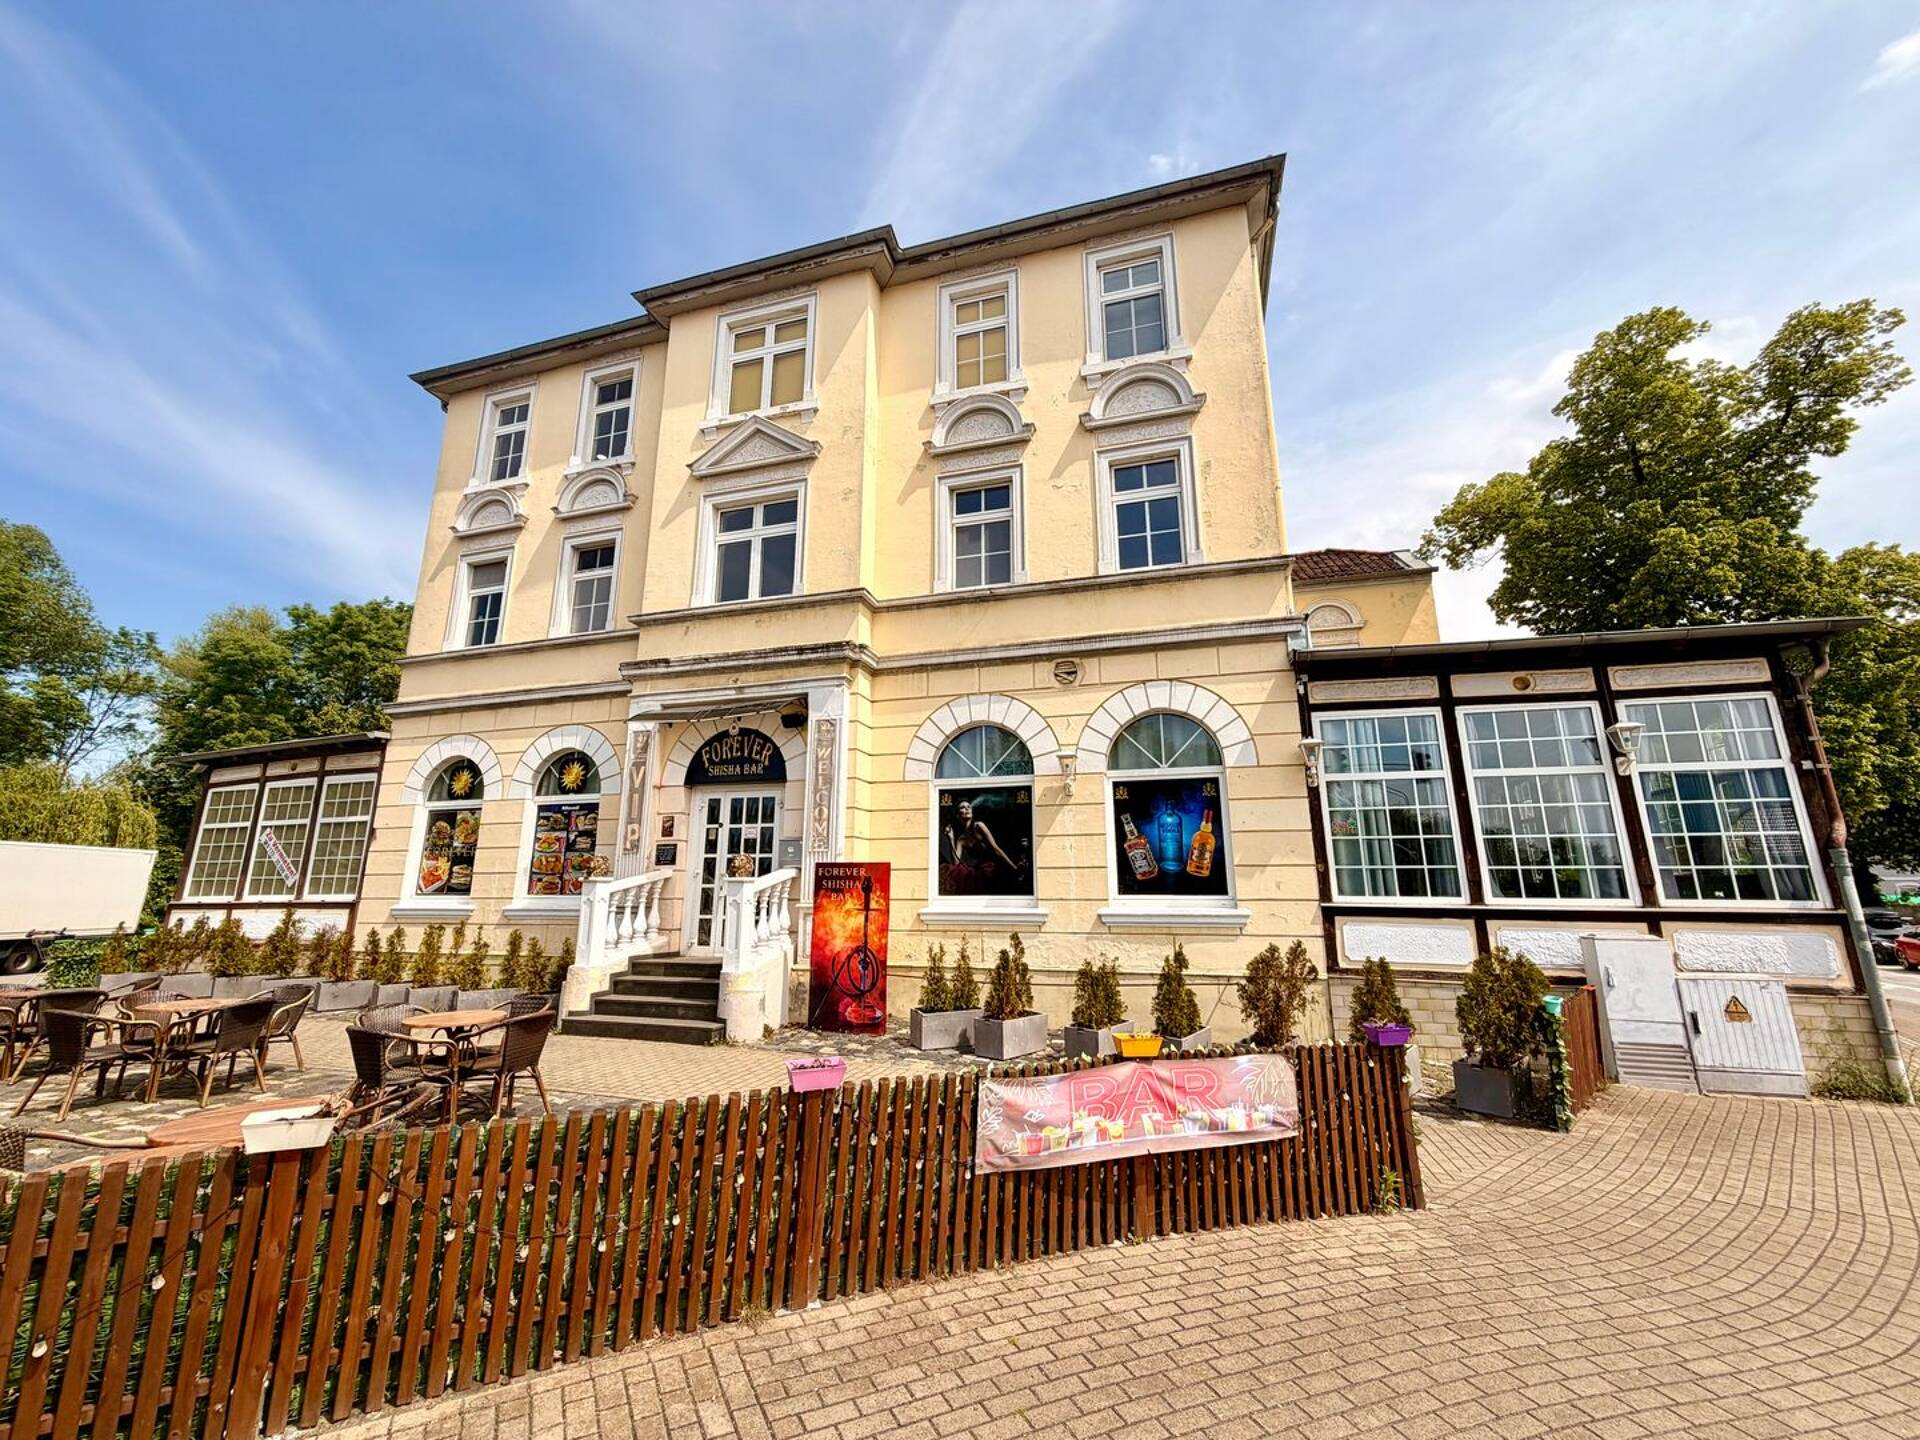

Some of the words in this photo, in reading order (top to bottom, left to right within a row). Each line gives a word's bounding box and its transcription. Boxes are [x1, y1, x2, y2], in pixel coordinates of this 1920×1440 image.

[702, 734, 774, 768] FOREVER
[708, 764, 741, 776] SHISHA
[743, 763, 764, 775] BAR
[626, 766, 646, 850] VIP
[814, 747, 832, 848] WELCOME
[817, 867, 867, 877] FOREVER
[822, 879, 861, 889] SHISHA
[831, 892, 851, 901] BAR
[1069, 1065, 1222, 1131] BAR
